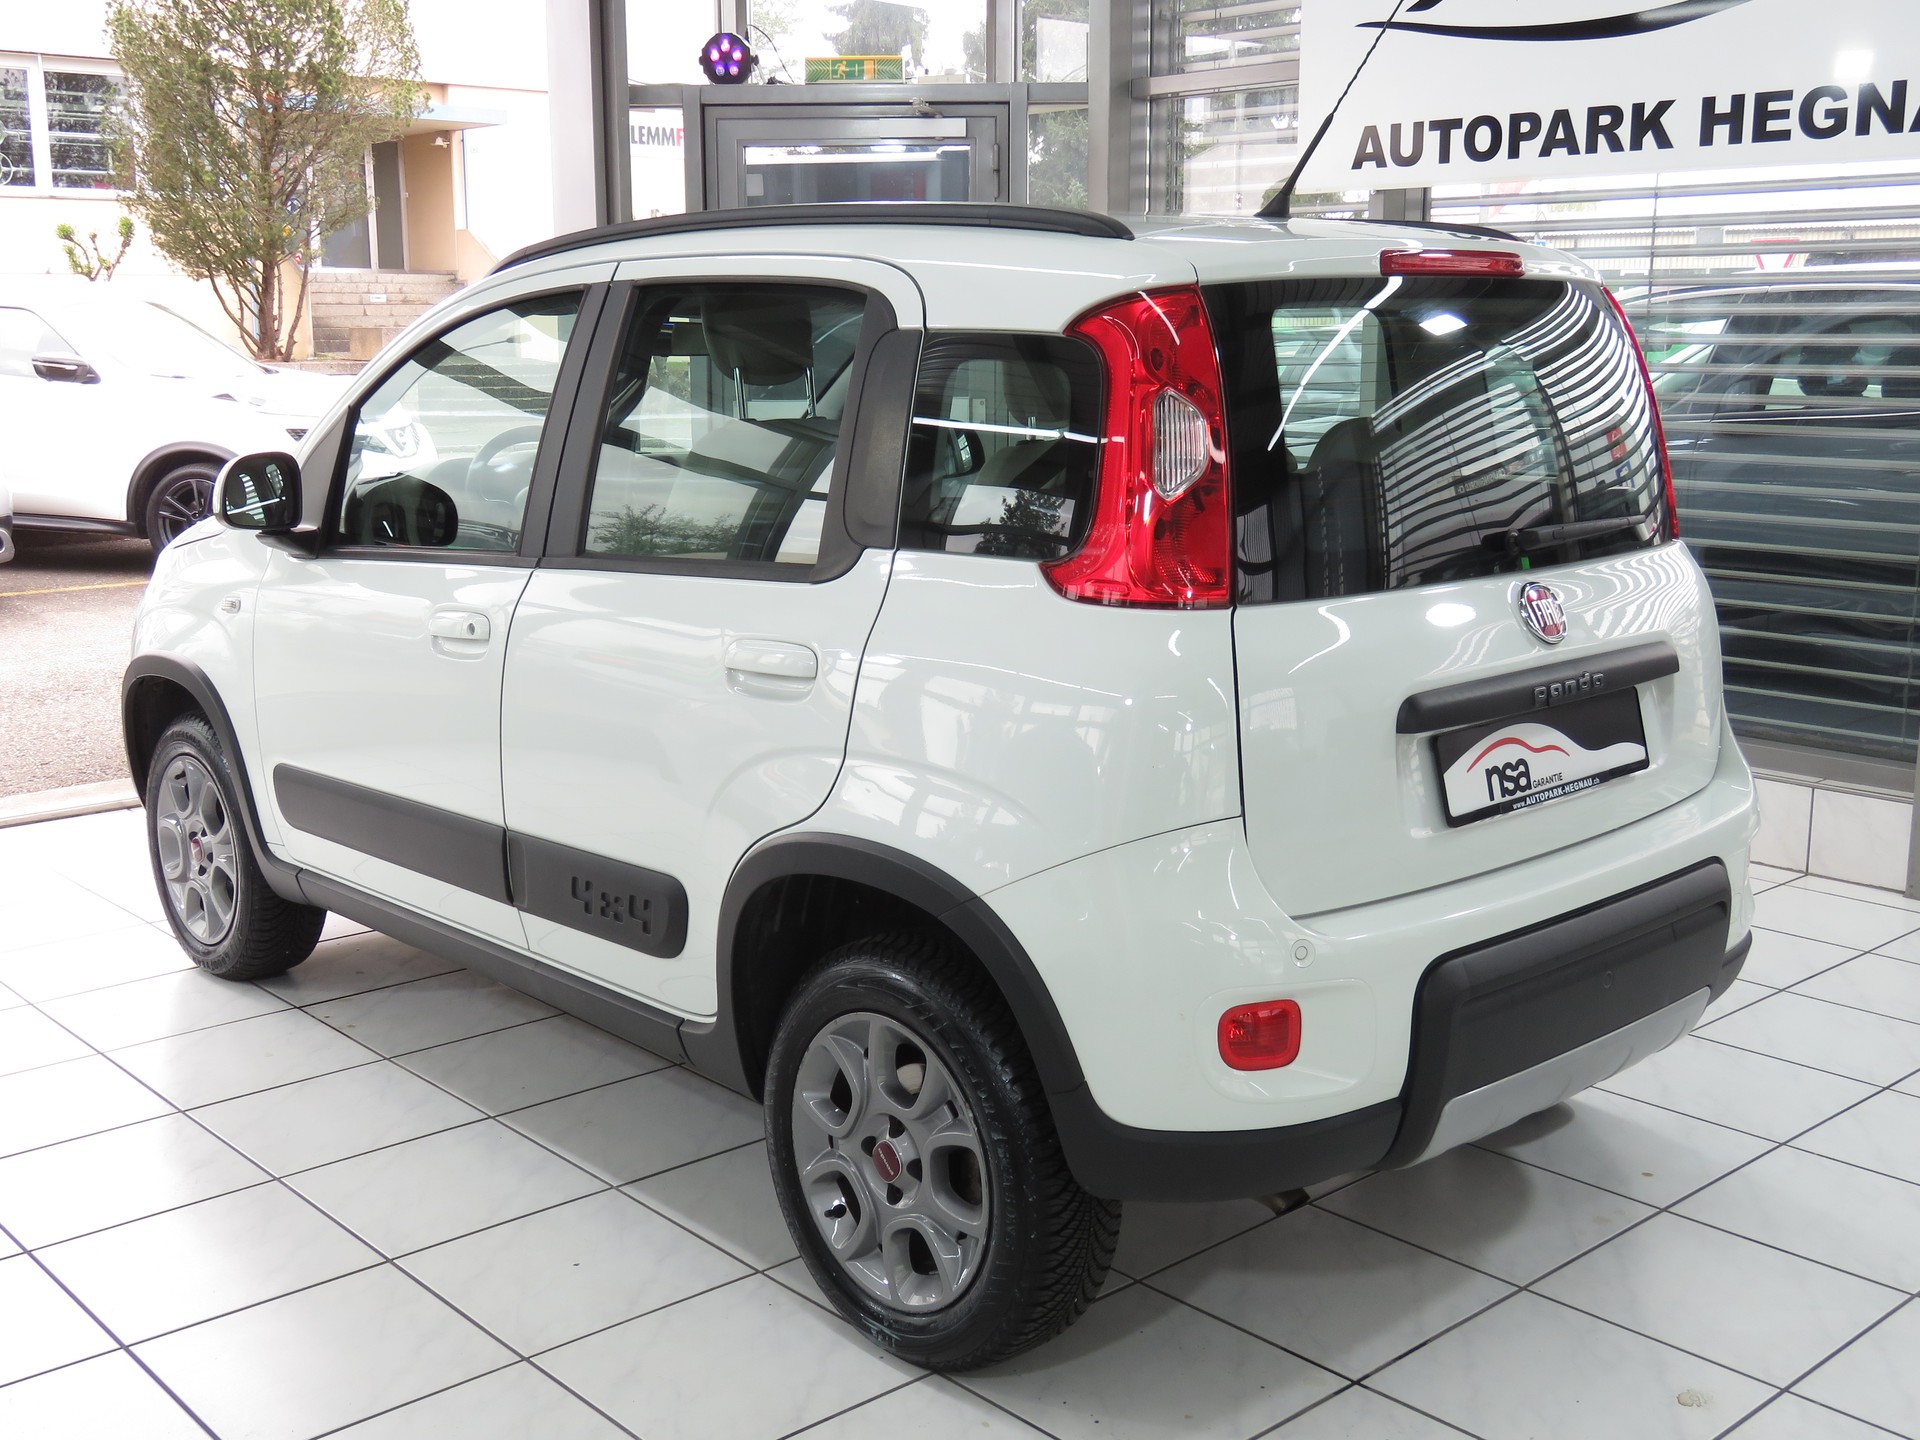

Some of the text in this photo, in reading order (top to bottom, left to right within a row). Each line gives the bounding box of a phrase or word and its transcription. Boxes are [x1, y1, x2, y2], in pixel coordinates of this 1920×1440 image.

[1351, 98, 1676, 170] AUTOPARK
[1531, 597, 1562, 628] FIAT
[1485, 757, 1563, 802] nsa GARANTIE
[1512, 777, 1601, 810] www.AUTOPARK-HEGNAU.ch
[571, 875, 653, 936] 4x4
